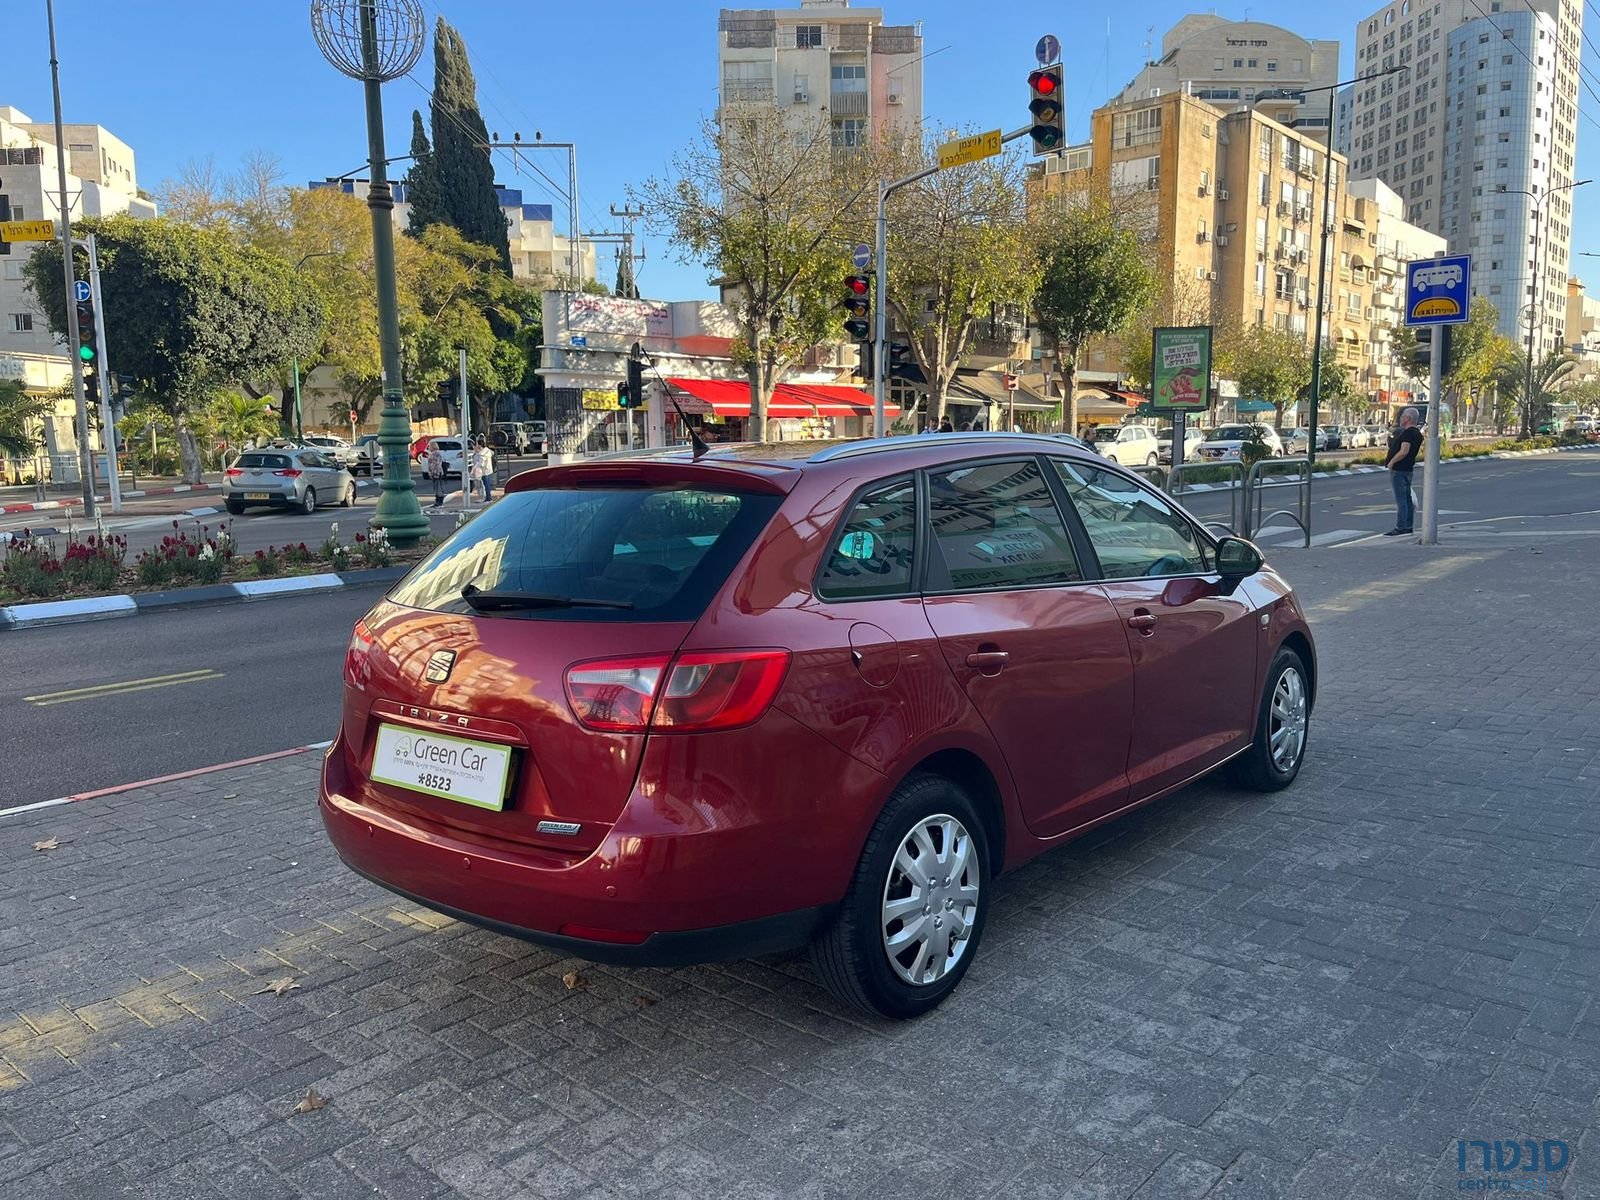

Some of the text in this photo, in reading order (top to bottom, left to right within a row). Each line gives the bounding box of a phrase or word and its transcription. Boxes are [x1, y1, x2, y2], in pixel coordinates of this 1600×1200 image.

[959, 139, 977, 152] ויצמן
[987, 137, 998, 150] 13
[8, 226, 23, 236] הרצל
[42, 225, 51, 234] 13
[608, 300, 628, 314] של
[400, 706, 469, 727] IBIZA
[414, 738, 488, 772] Green Car
